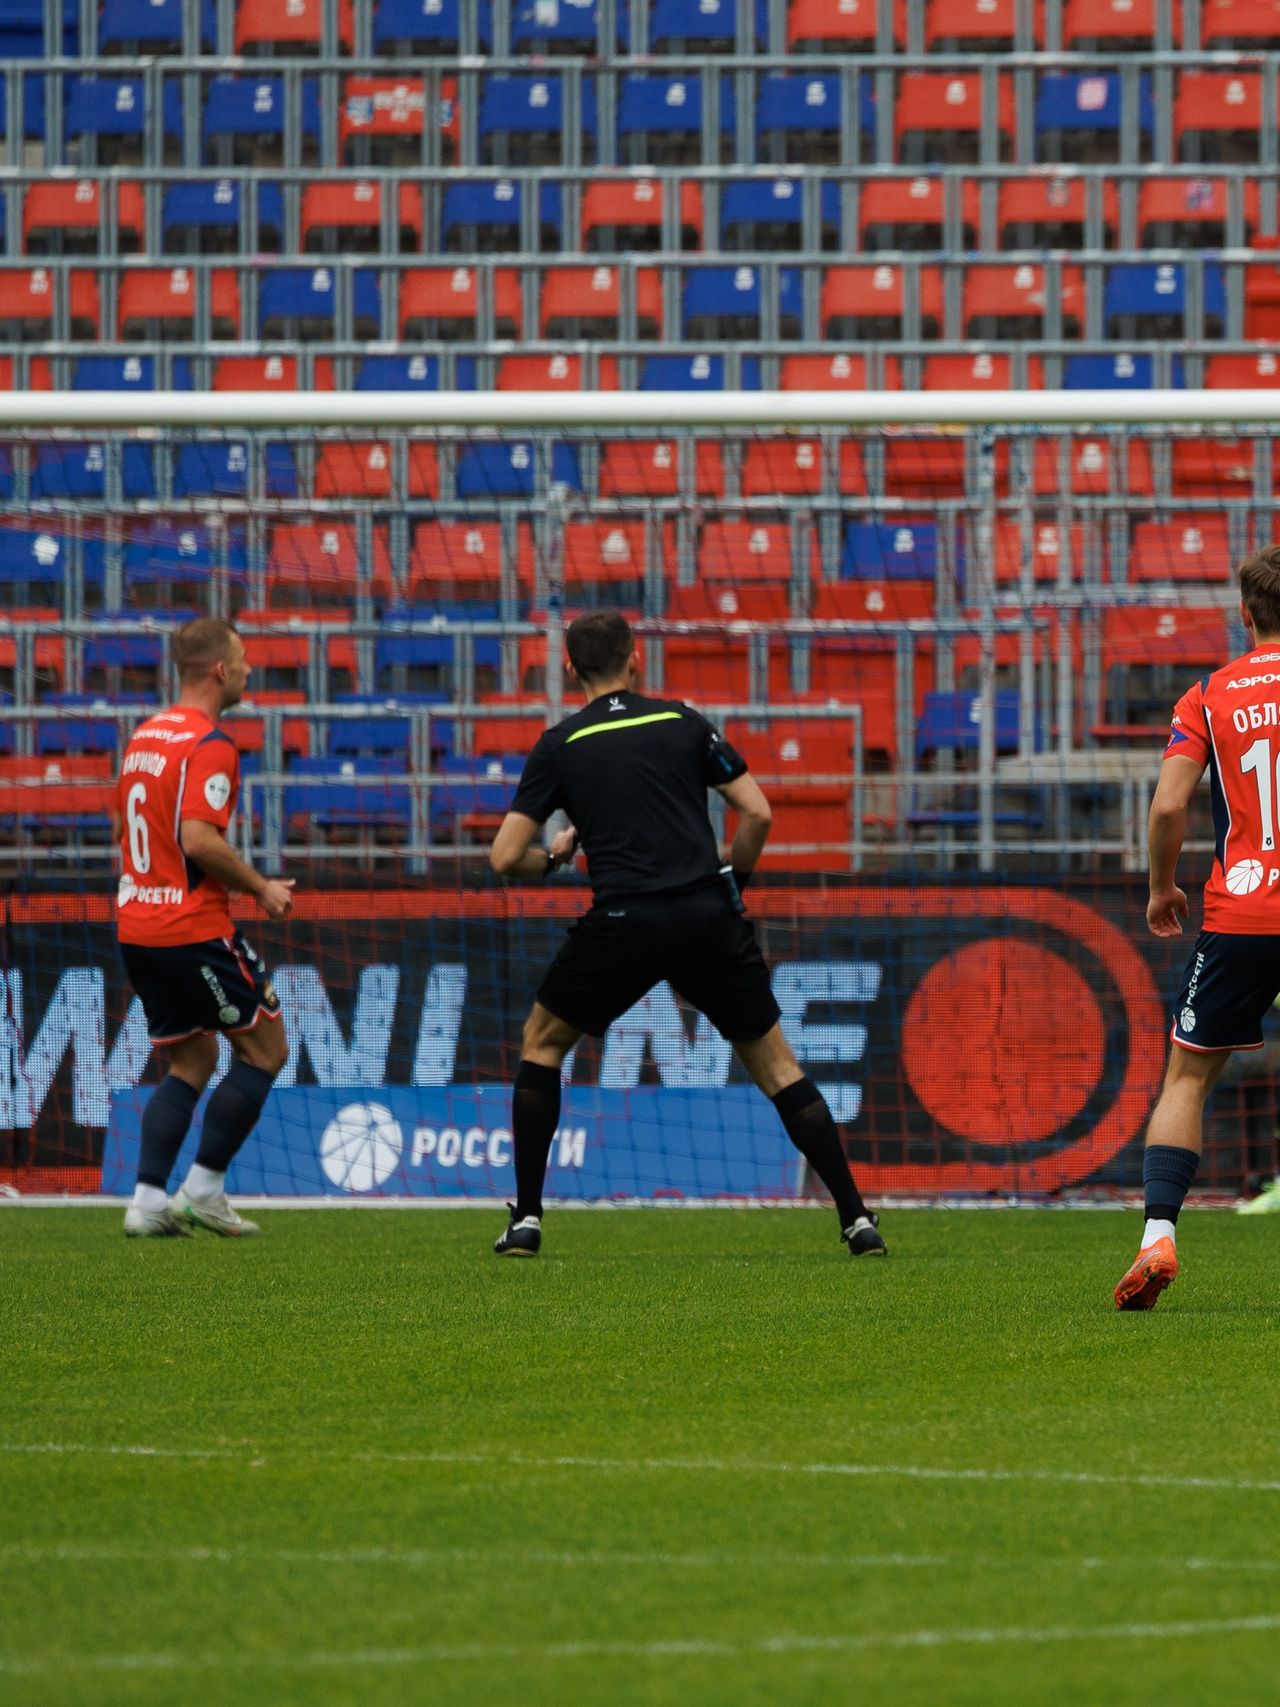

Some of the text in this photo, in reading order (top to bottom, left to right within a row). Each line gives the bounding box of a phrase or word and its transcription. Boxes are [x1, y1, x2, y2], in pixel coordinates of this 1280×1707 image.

[127, 782, 150, 875] 6
[1186, 951, 1205, 1006] РОССЕТИ
[410, 1126, 588, 1168] РОССИ
